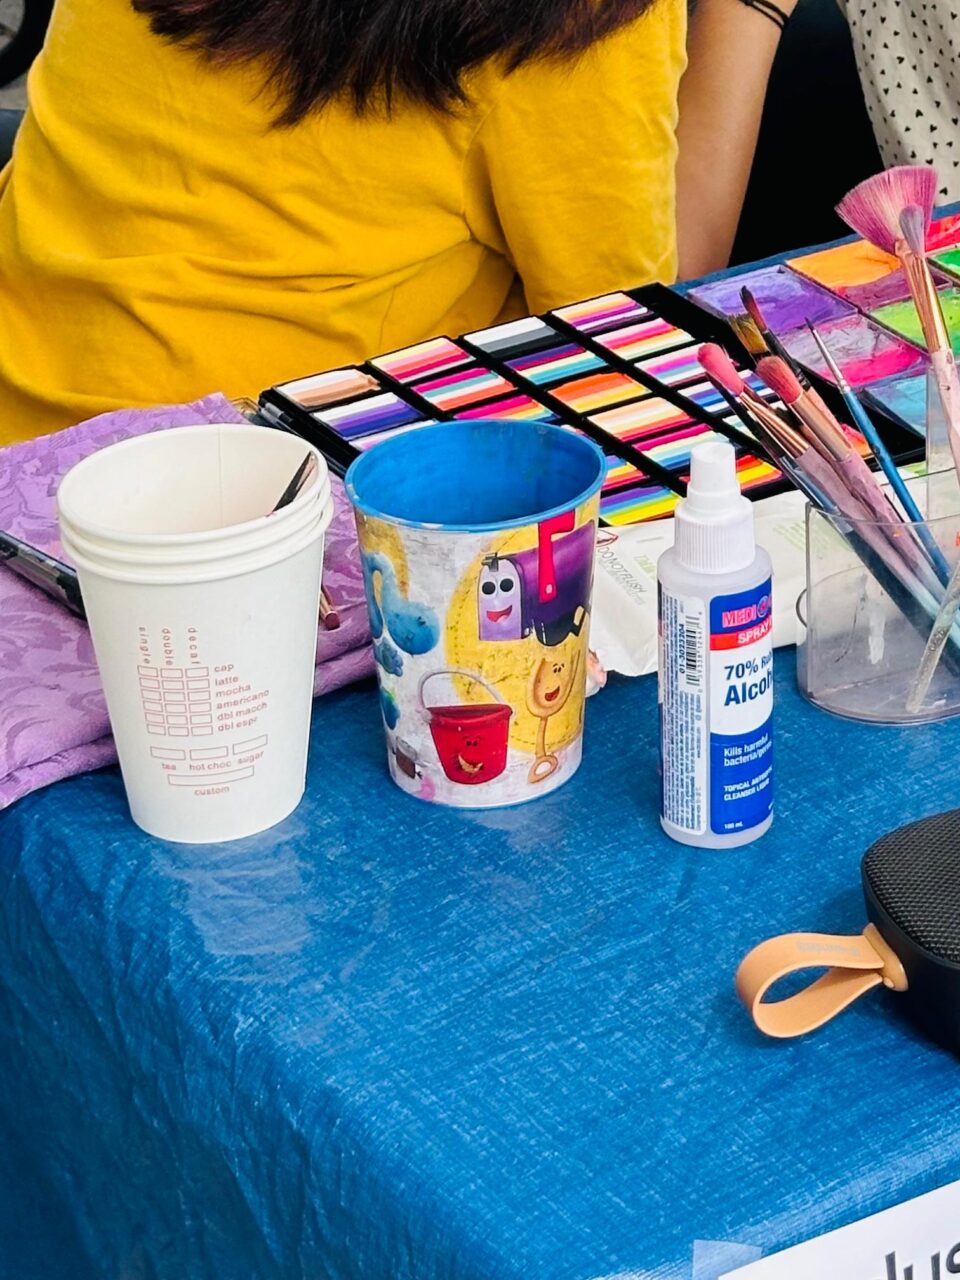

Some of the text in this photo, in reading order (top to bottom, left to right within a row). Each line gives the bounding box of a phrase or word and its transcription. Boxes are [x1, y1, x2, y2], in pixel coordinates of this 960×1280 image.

[138, 626, 151, 664] single
[162, 627, 175, 666] double
[188, 627, 201, 665] decaf
[214, 663, 234, 673] cap
[724, 658, 758, 681] 70%
[215, 676, 239, 686] latte
[216, 684, 251, 697] mocha
[216, 689, 270, 710] americano
[217, 702, 268, 721] dbl macch
[218, 722, 234, 732] dbl
[161, 751, 265, 771] tea hot choc sugar
[724, 746, 742, 757] Kills
[194, 785, 230, 796] custom
